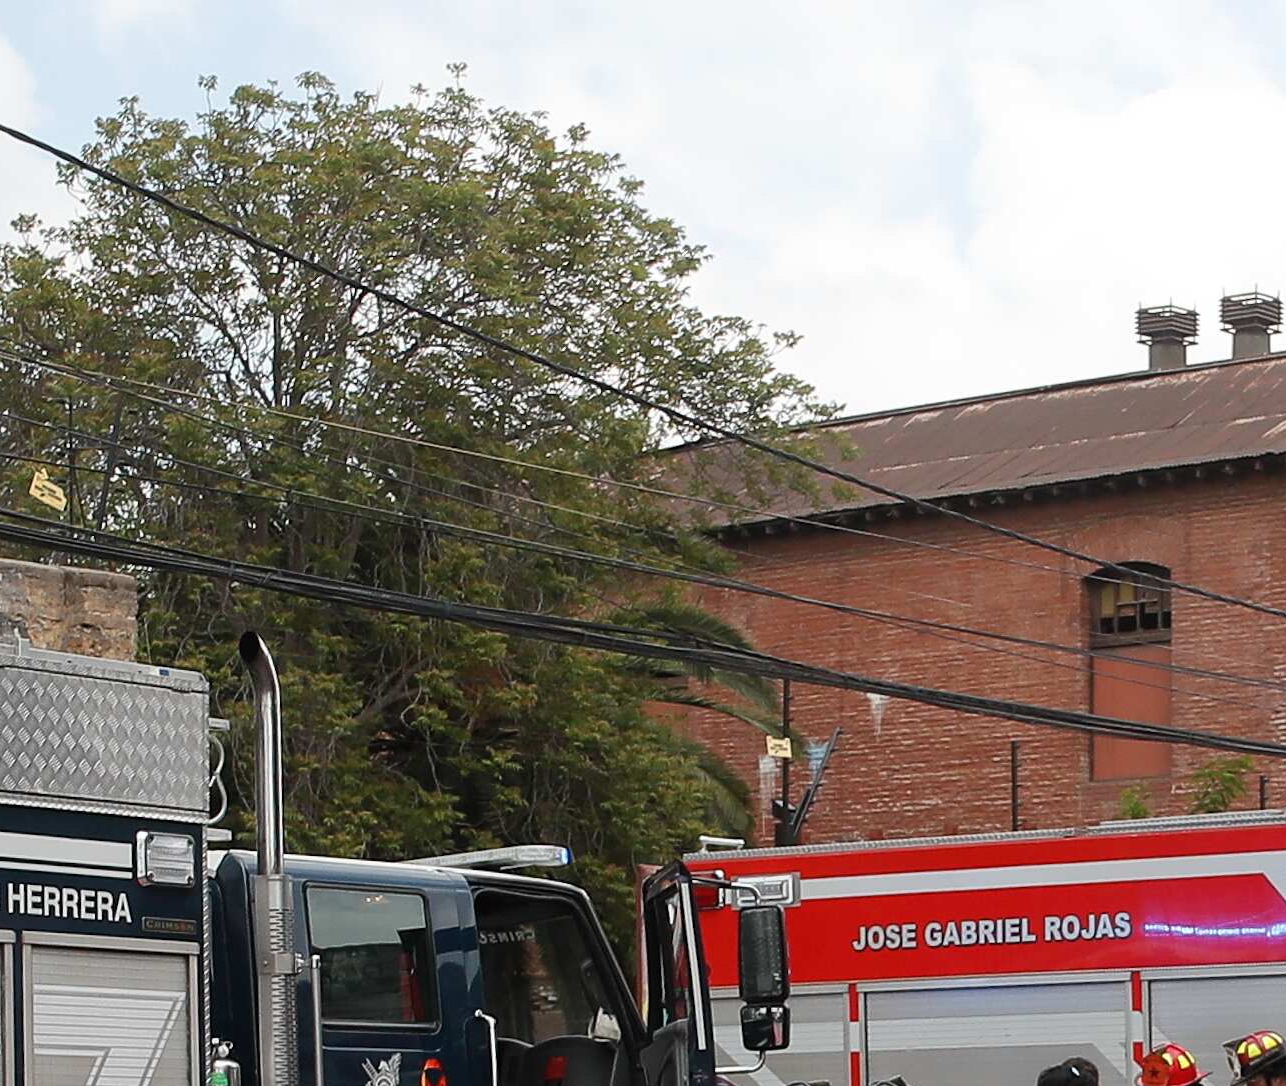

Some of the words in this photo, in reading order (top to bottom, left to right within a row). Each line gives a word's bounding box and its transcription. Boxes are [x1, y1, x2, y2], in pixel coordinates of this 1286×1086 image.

[8, 883, 132, 923] HERRERA
[852, 924, 917, 950] JOSE
[924, 918, 1036, 947] GABRIEL
[1044, 912, 1131, 941] ROJAS
